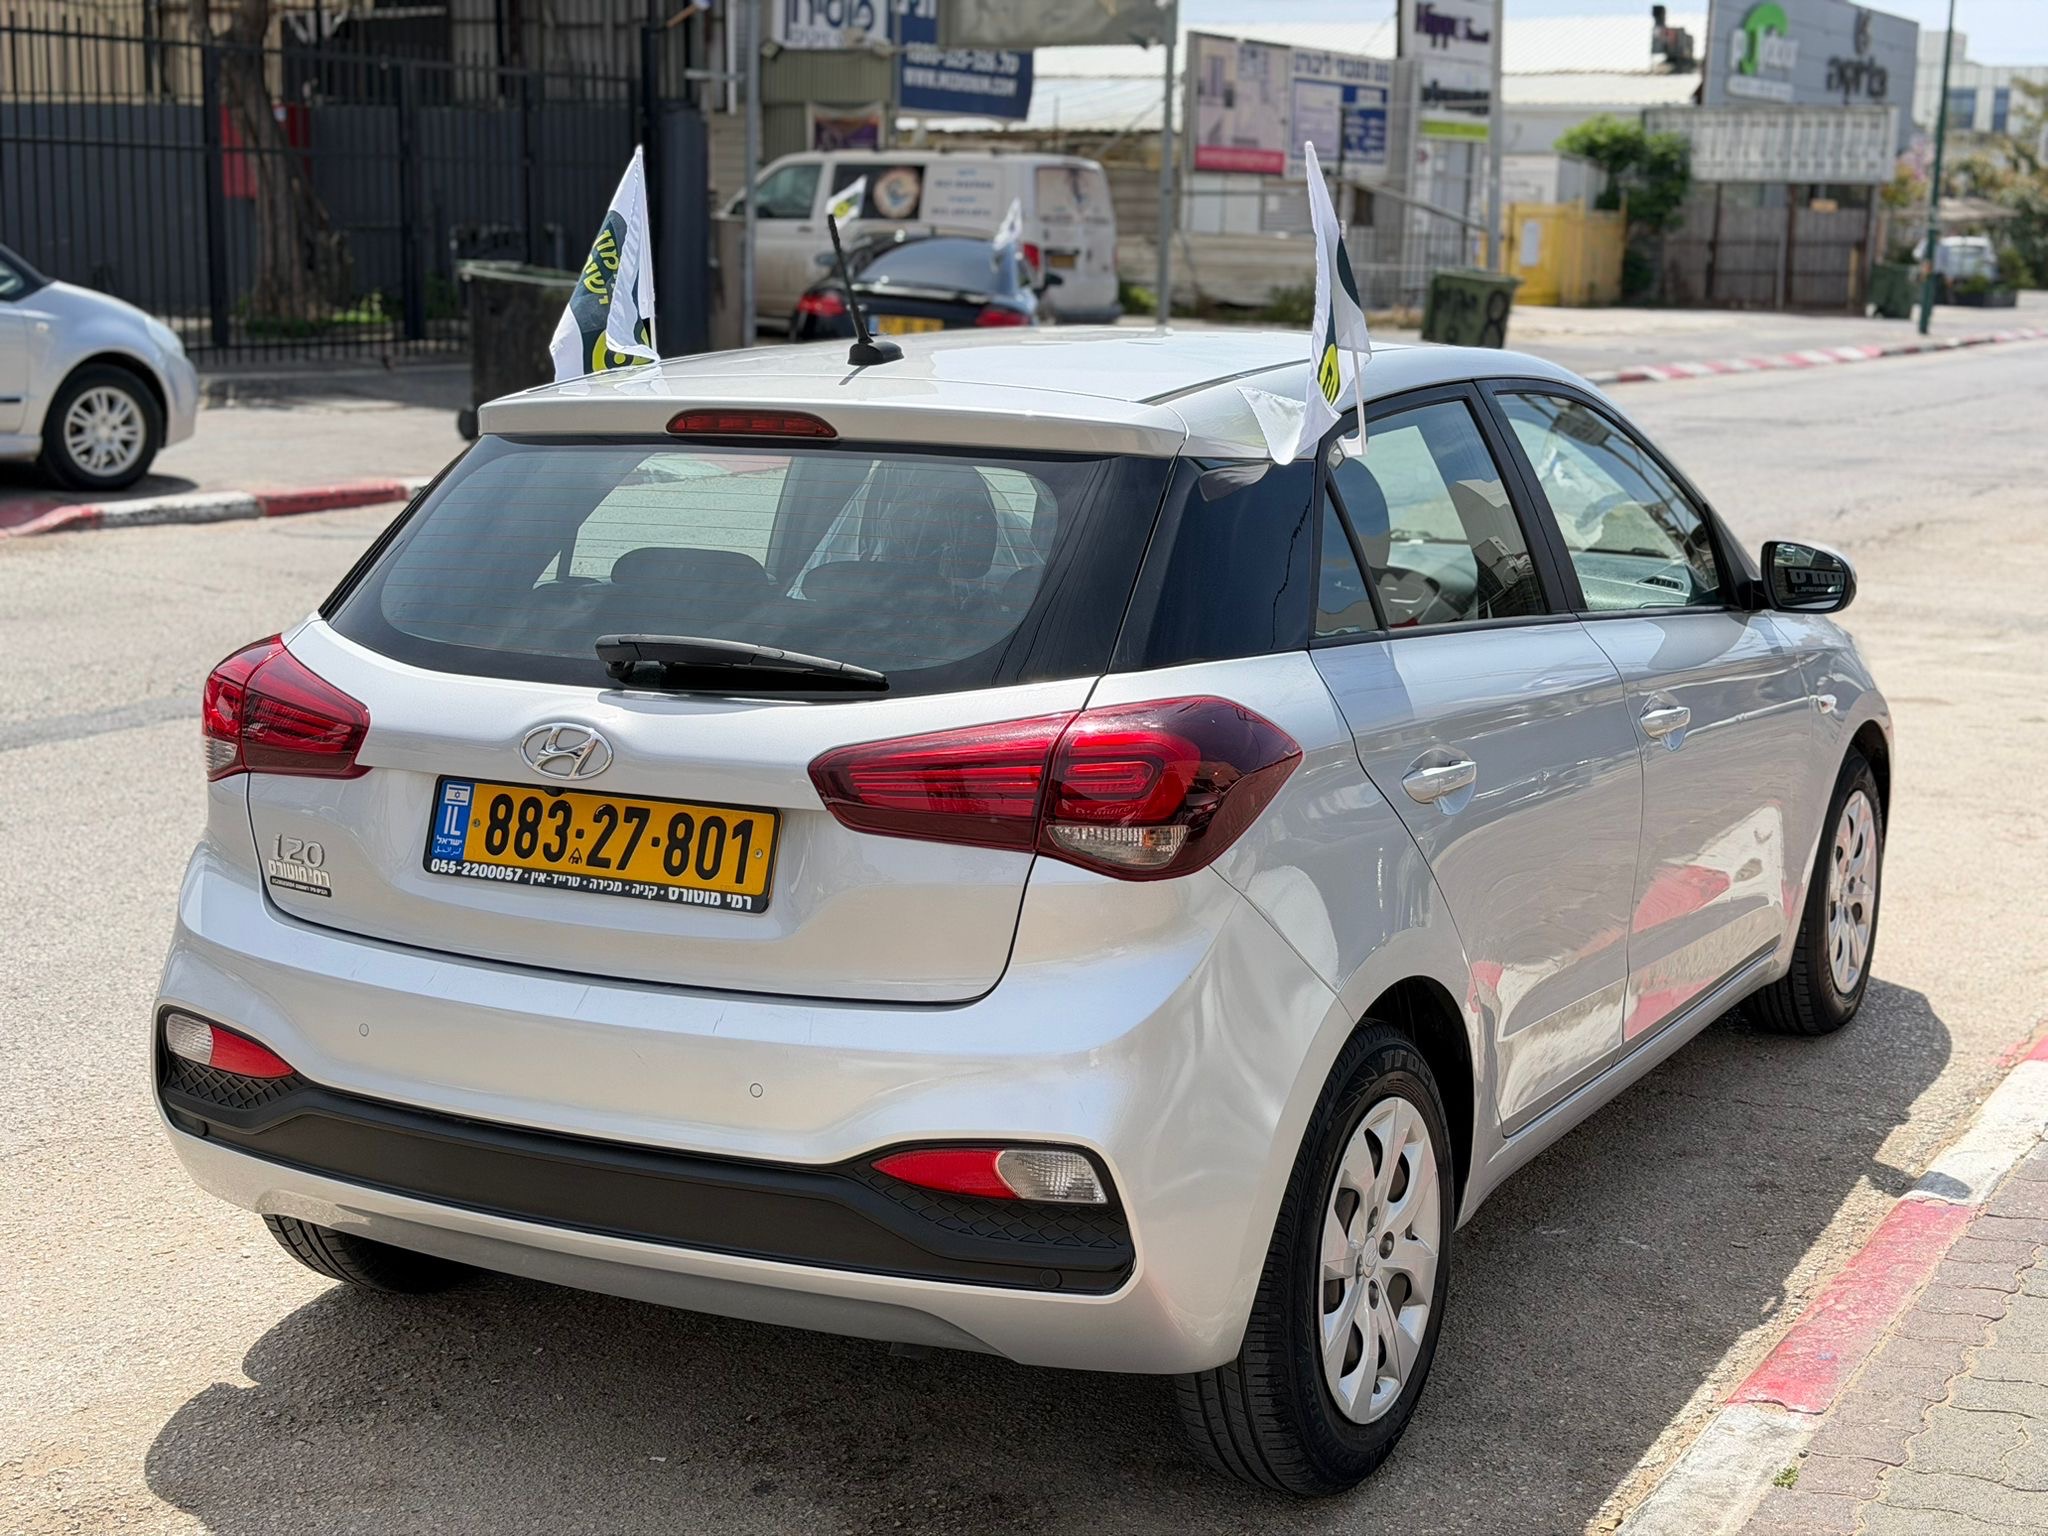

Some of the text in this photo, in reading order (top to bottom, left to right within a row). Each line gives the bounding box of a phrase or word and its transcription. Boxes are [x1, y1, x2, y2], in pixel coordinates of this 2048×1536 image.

[443, 805, 462, 836] IL
[273, 833, 325, 868] i20
[436, 834, 463, 846] ישראל
[268, 859, 308, 883] מוטורס
[309, 868, 331, 887] רמי
[430, 858, 752, 910] רמי מוטורס קניה מכירה טרייד-אין 055-2200057
